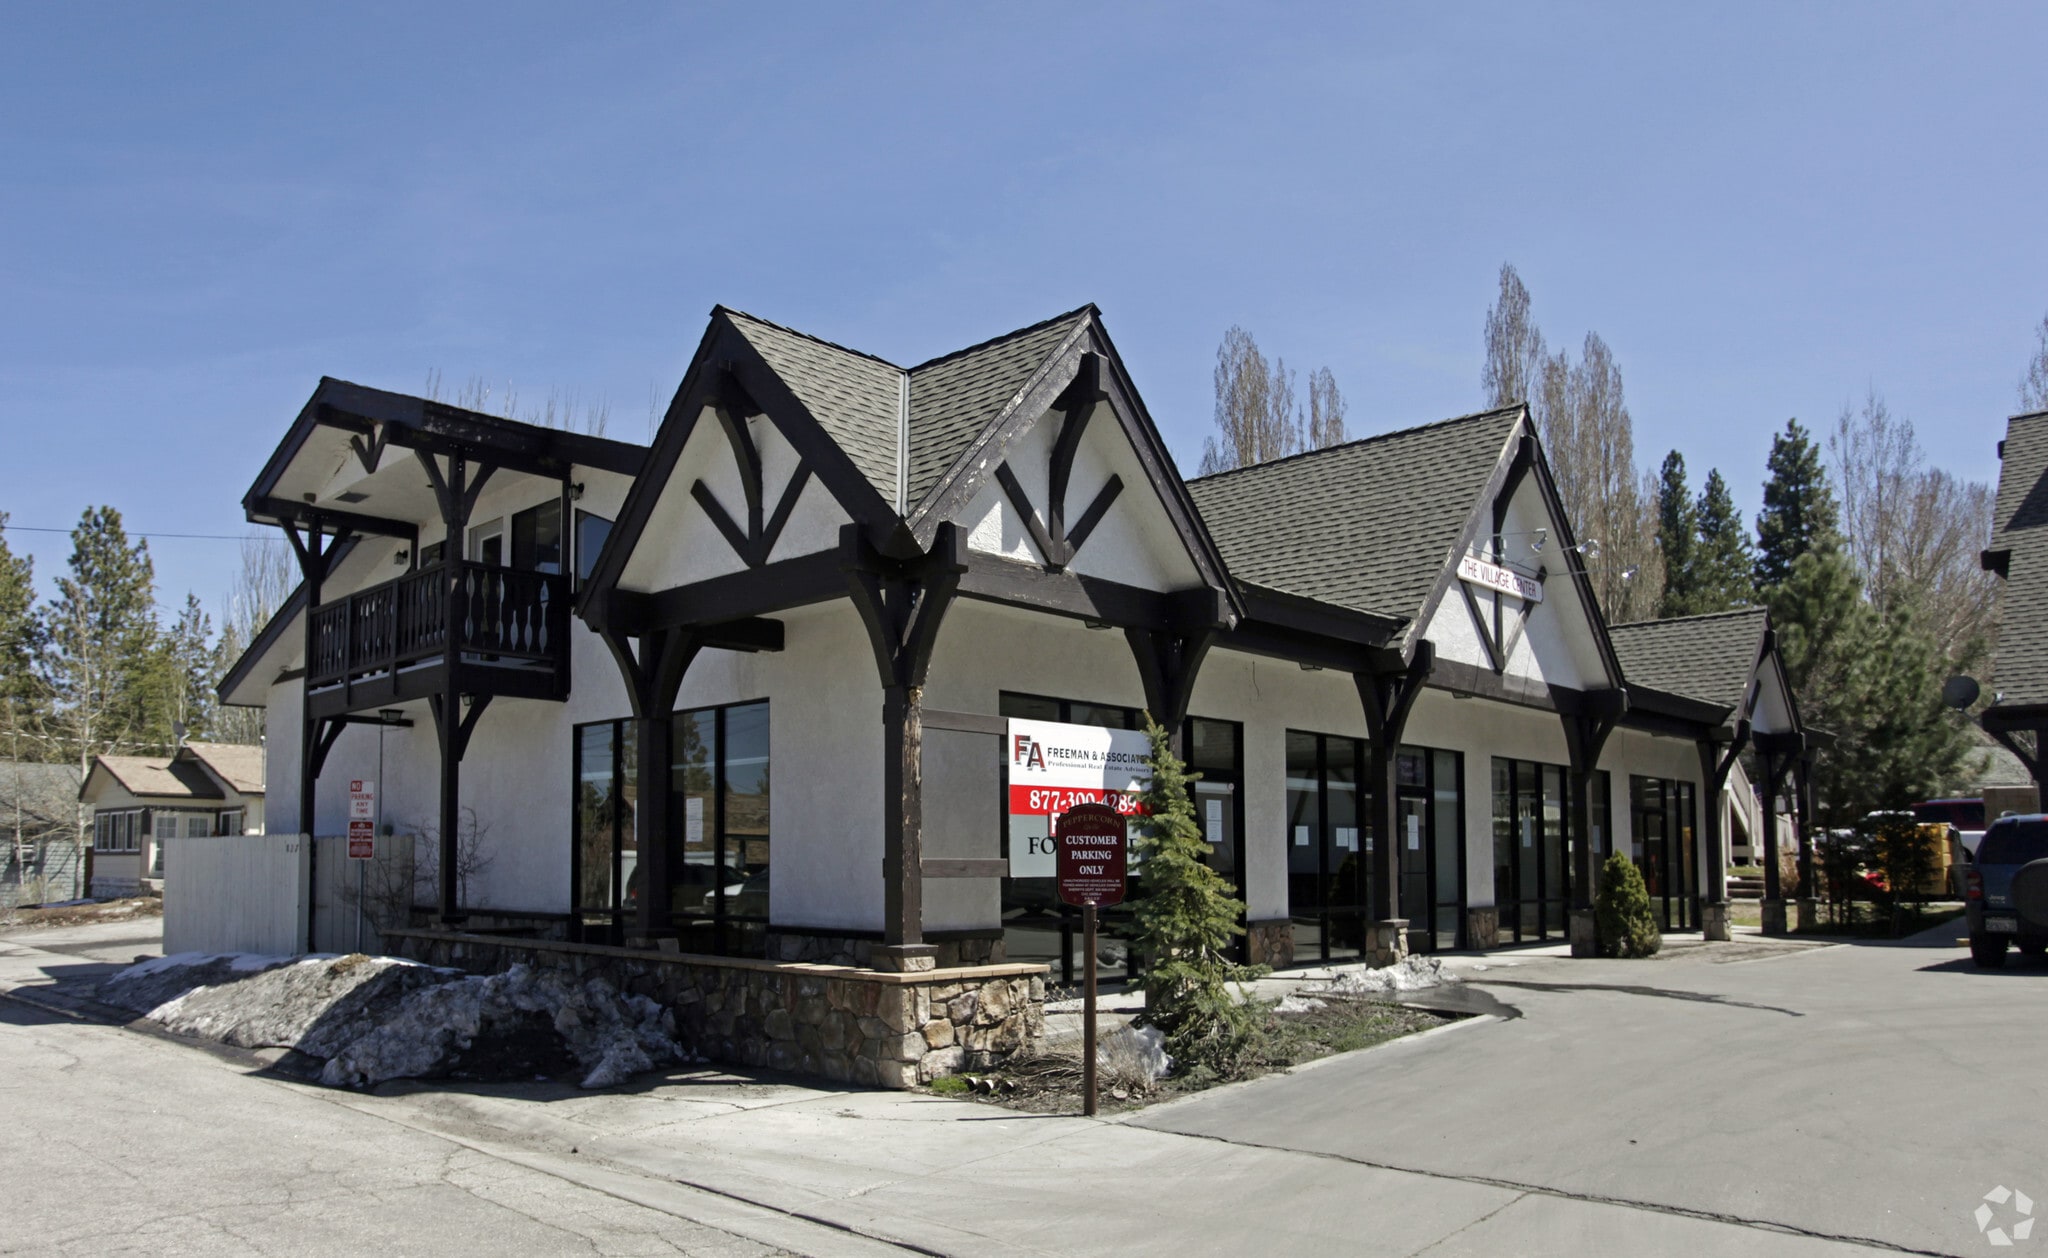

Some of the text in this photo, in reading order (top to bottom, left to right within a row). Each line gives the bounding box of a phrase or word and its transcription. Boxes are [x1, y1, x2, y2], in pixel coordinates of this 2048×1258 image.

[1464, 559, 1537, 598] THE VILLAGE CENTER
[1047, 747, 1150, 765] FREEMAN & ASSOCIATE
[1048, 761, 1087, 769] Professional
[1062, 814, 1121, 828] PEPPERCORN
[1028, 837, 1057, 854] FO
[1065, 835, 1118, 845] CUSTOMER
[1071, 850, 1112, 860] PARKING
[1079, 865, 1104, 875] ONLY
